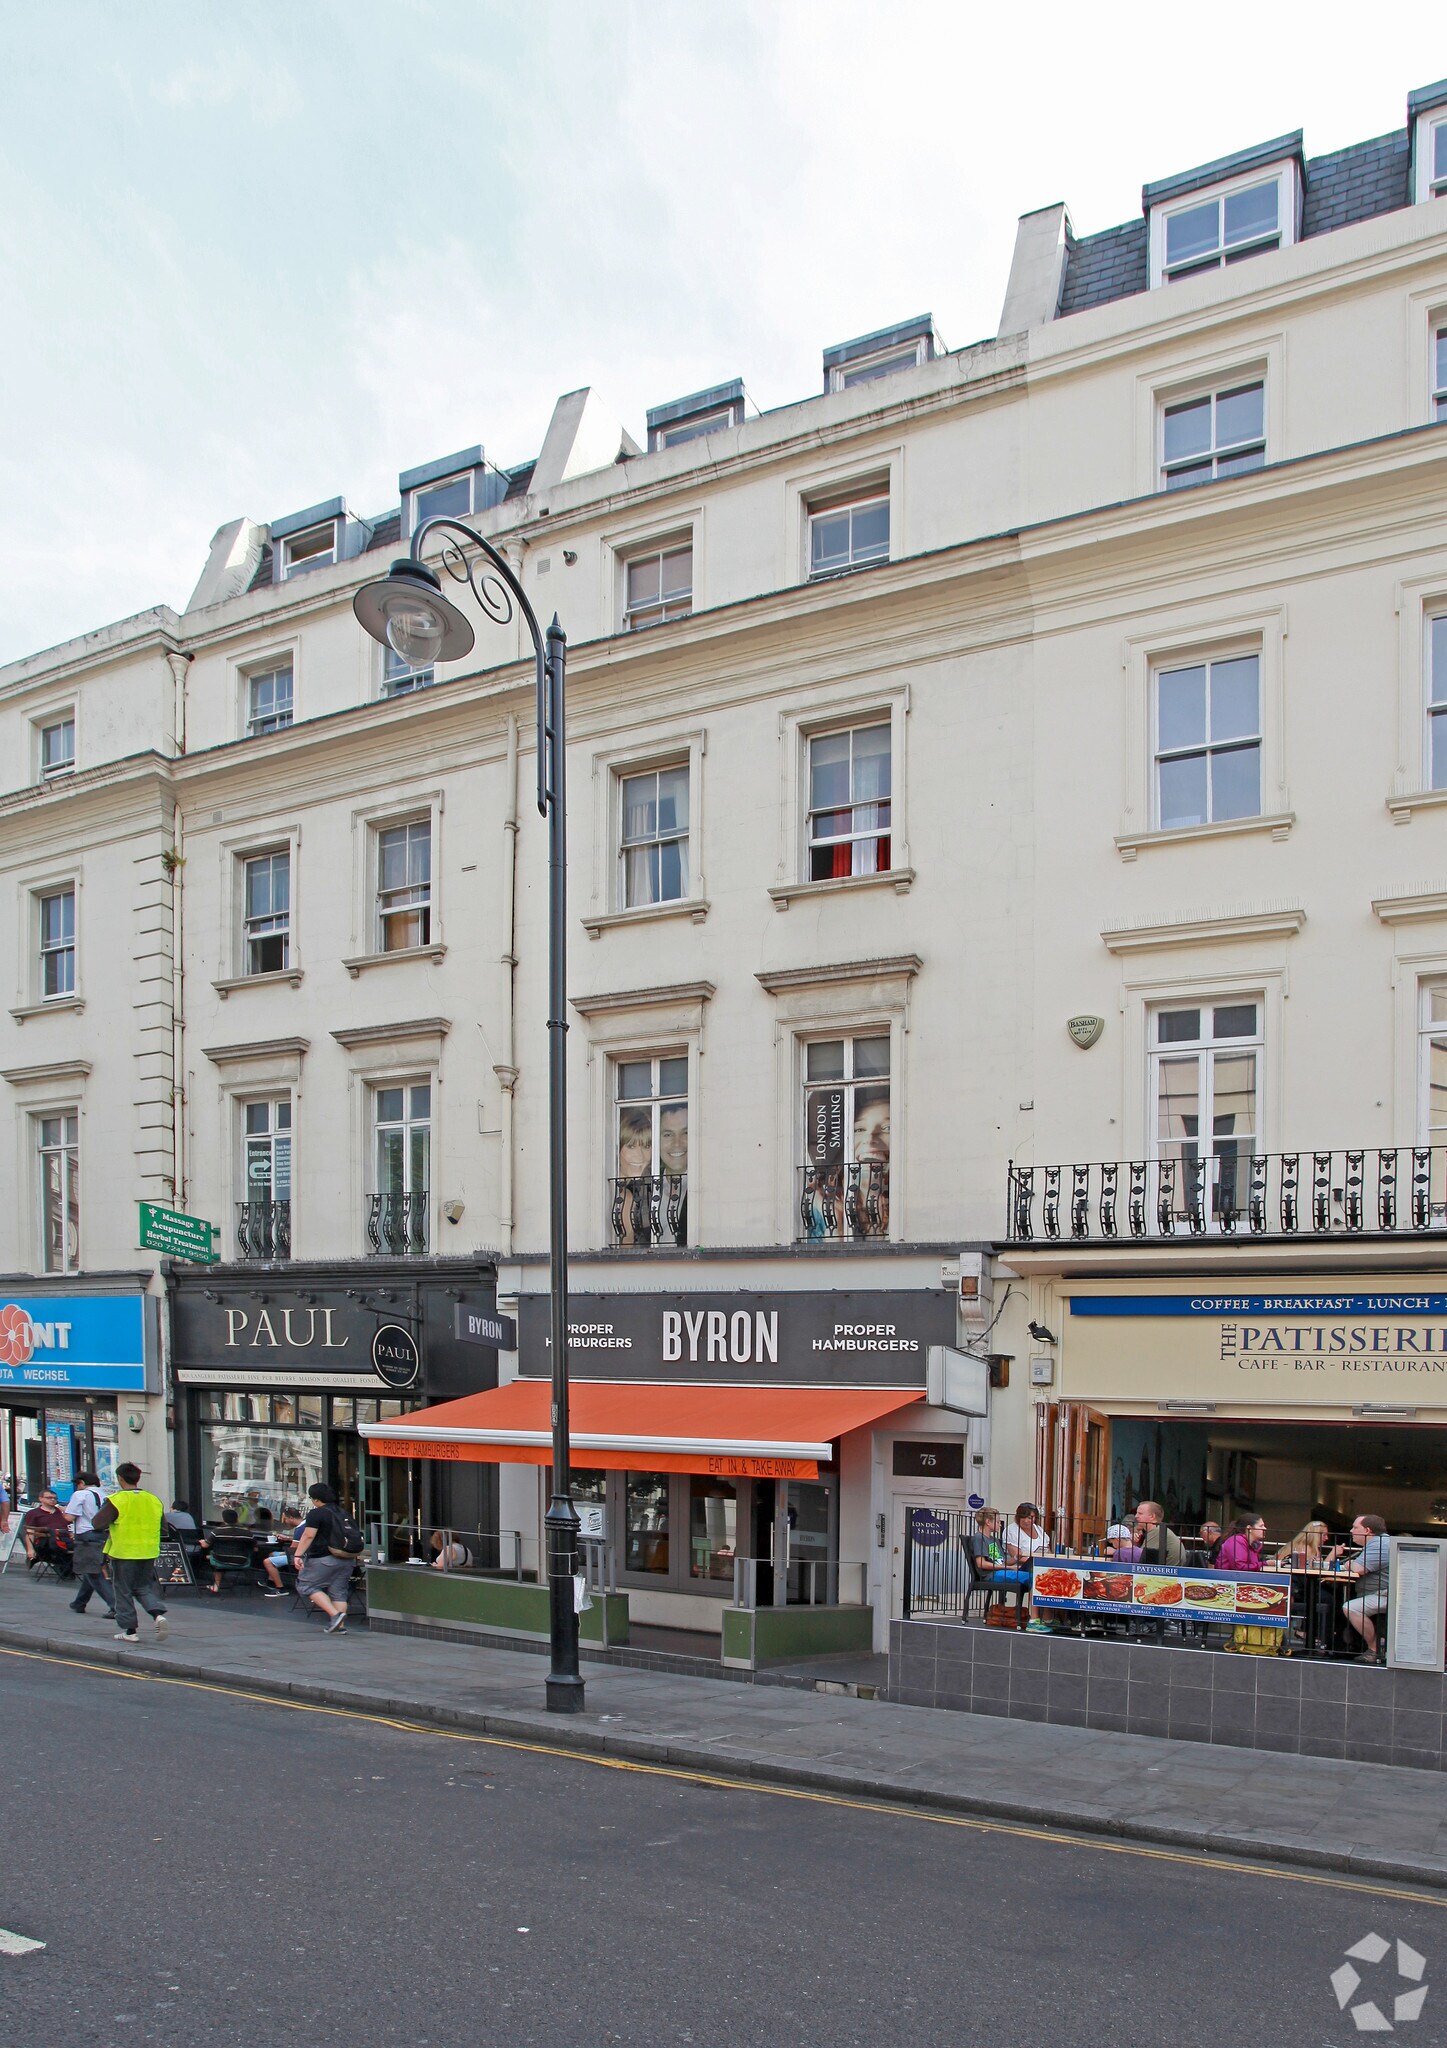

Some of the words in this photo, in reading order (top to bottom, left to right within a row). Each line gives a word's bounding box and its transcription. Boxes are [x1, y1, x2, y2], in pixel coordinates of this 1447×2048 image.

[1070, 1019, 1096, 1028] BANHAM
[830, 1094, 841, 1148] SMILING
[816, 1105, 826, 1160] LONDON
[162, 1213, 194, 1228] Massage
[152, 1221, 204, 1241] Acupuncture
[146, 1240, 163, 1248] 020
[166, 1244, 186, 1254] 7244
[188, 1251, 209, 1260] 9550
[147, 1230, 171, 1243] Herbal
[173, 1238, 208, 1253] Treatment
[1190, 1299, 1250, 1310] COFFEE
[1263, 1298, 1354, 1309] BREAKFAST
[1367, 1298, 1430, 1309] LUNCH
[224, 1308, 349, 1347] PAUL
[468, 1315, 503, 1340] BYRON
[834, 1324, 896, 1335] PROPER
[545, 1337, 633, 1348] HMBURGERS
[662, 1310, 778, 1363] BYRON
[812, 1339, 919, 1351] HAMBURGERS
[1219, 1323, 1238, 1360] THE
[377, 1344, 414, 1361] PAUL
[1238, 1359, 1279, 1370] CAFE
[1294, 1360, 1326, 1371] BAR
[1342, 1360, 1447, 1372] RESTAURAN
[23, 1370, 70, 1381] WECHSEL
[383, 1440, 410, 1456] PROPER
[413, 1442, 460, 1459] HAMBURGERS
[709, 1457, 723, 1473] EAT
[728, 1458, 737, 1474] IN
[741, 1459, 748, 1474] &
[920, 1454, 937, 1466] 75
[1136, 1565, 1179, 1575] PATISSERIE
